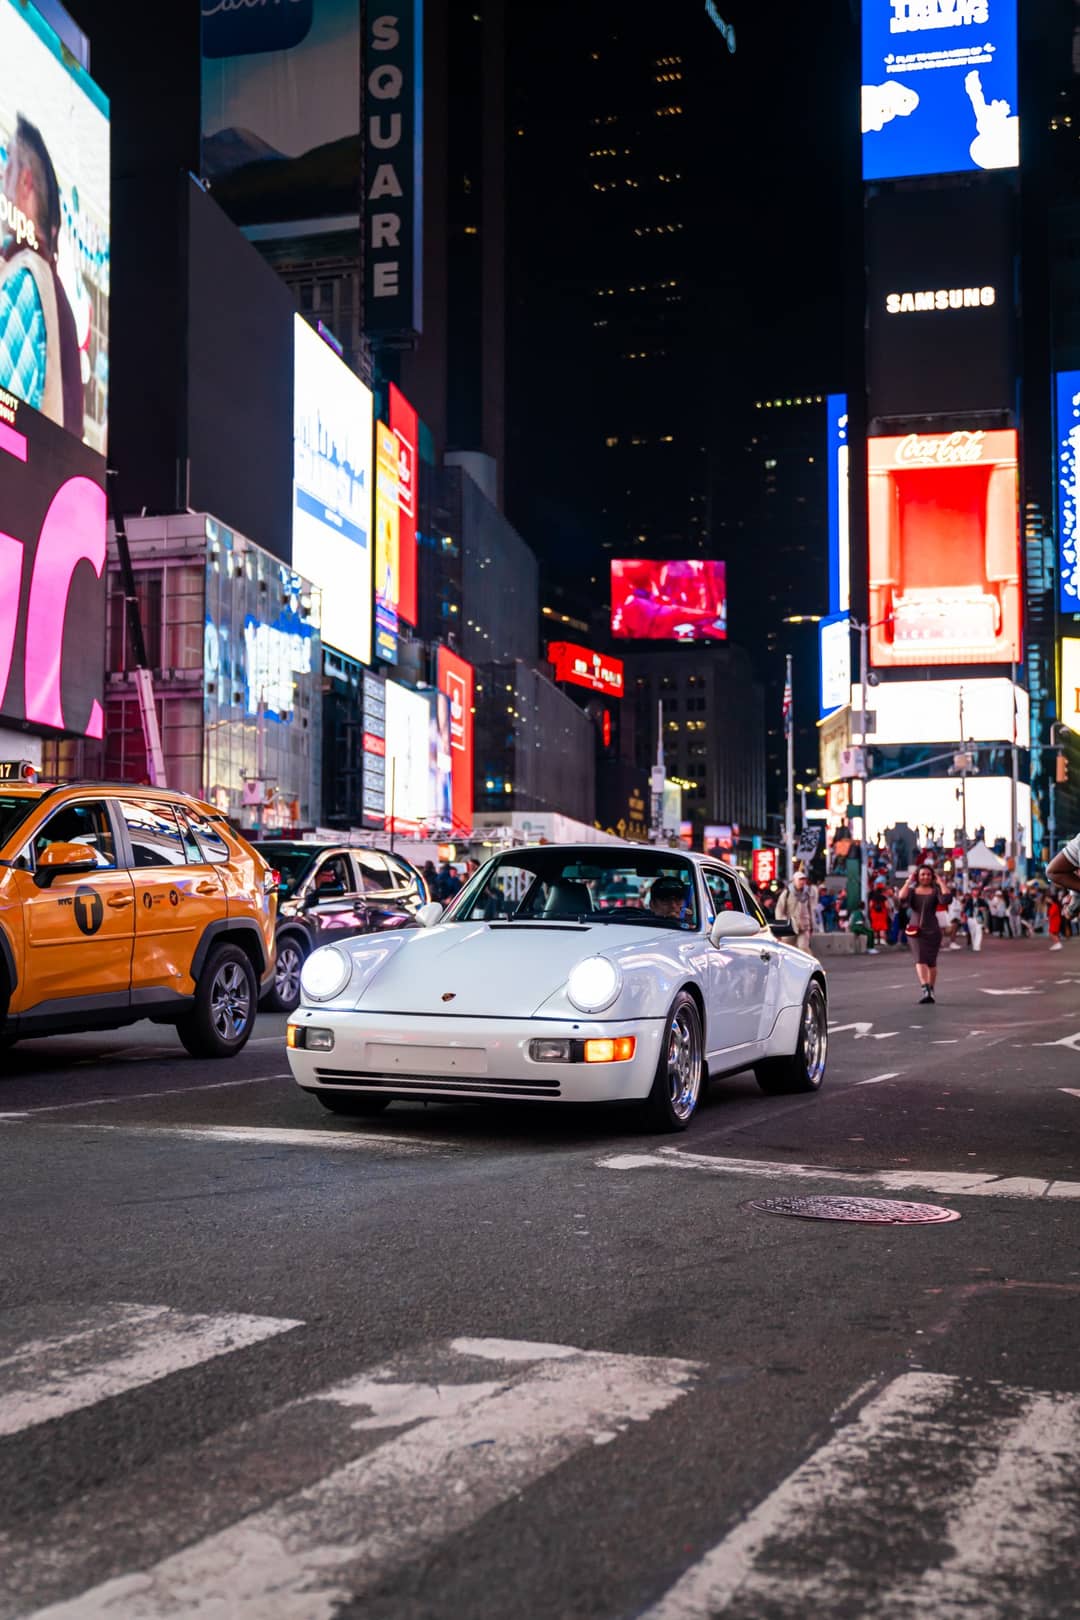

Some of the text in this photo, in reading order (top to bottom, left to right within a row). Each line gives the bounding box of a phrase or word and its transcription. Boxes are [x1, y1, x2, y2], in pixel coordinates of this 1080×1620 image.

[368, 15, 403, 297] SQUARE
[886, 286, 995, 314] SAMSUNG
[57, 894, 97, 929] NYC T
